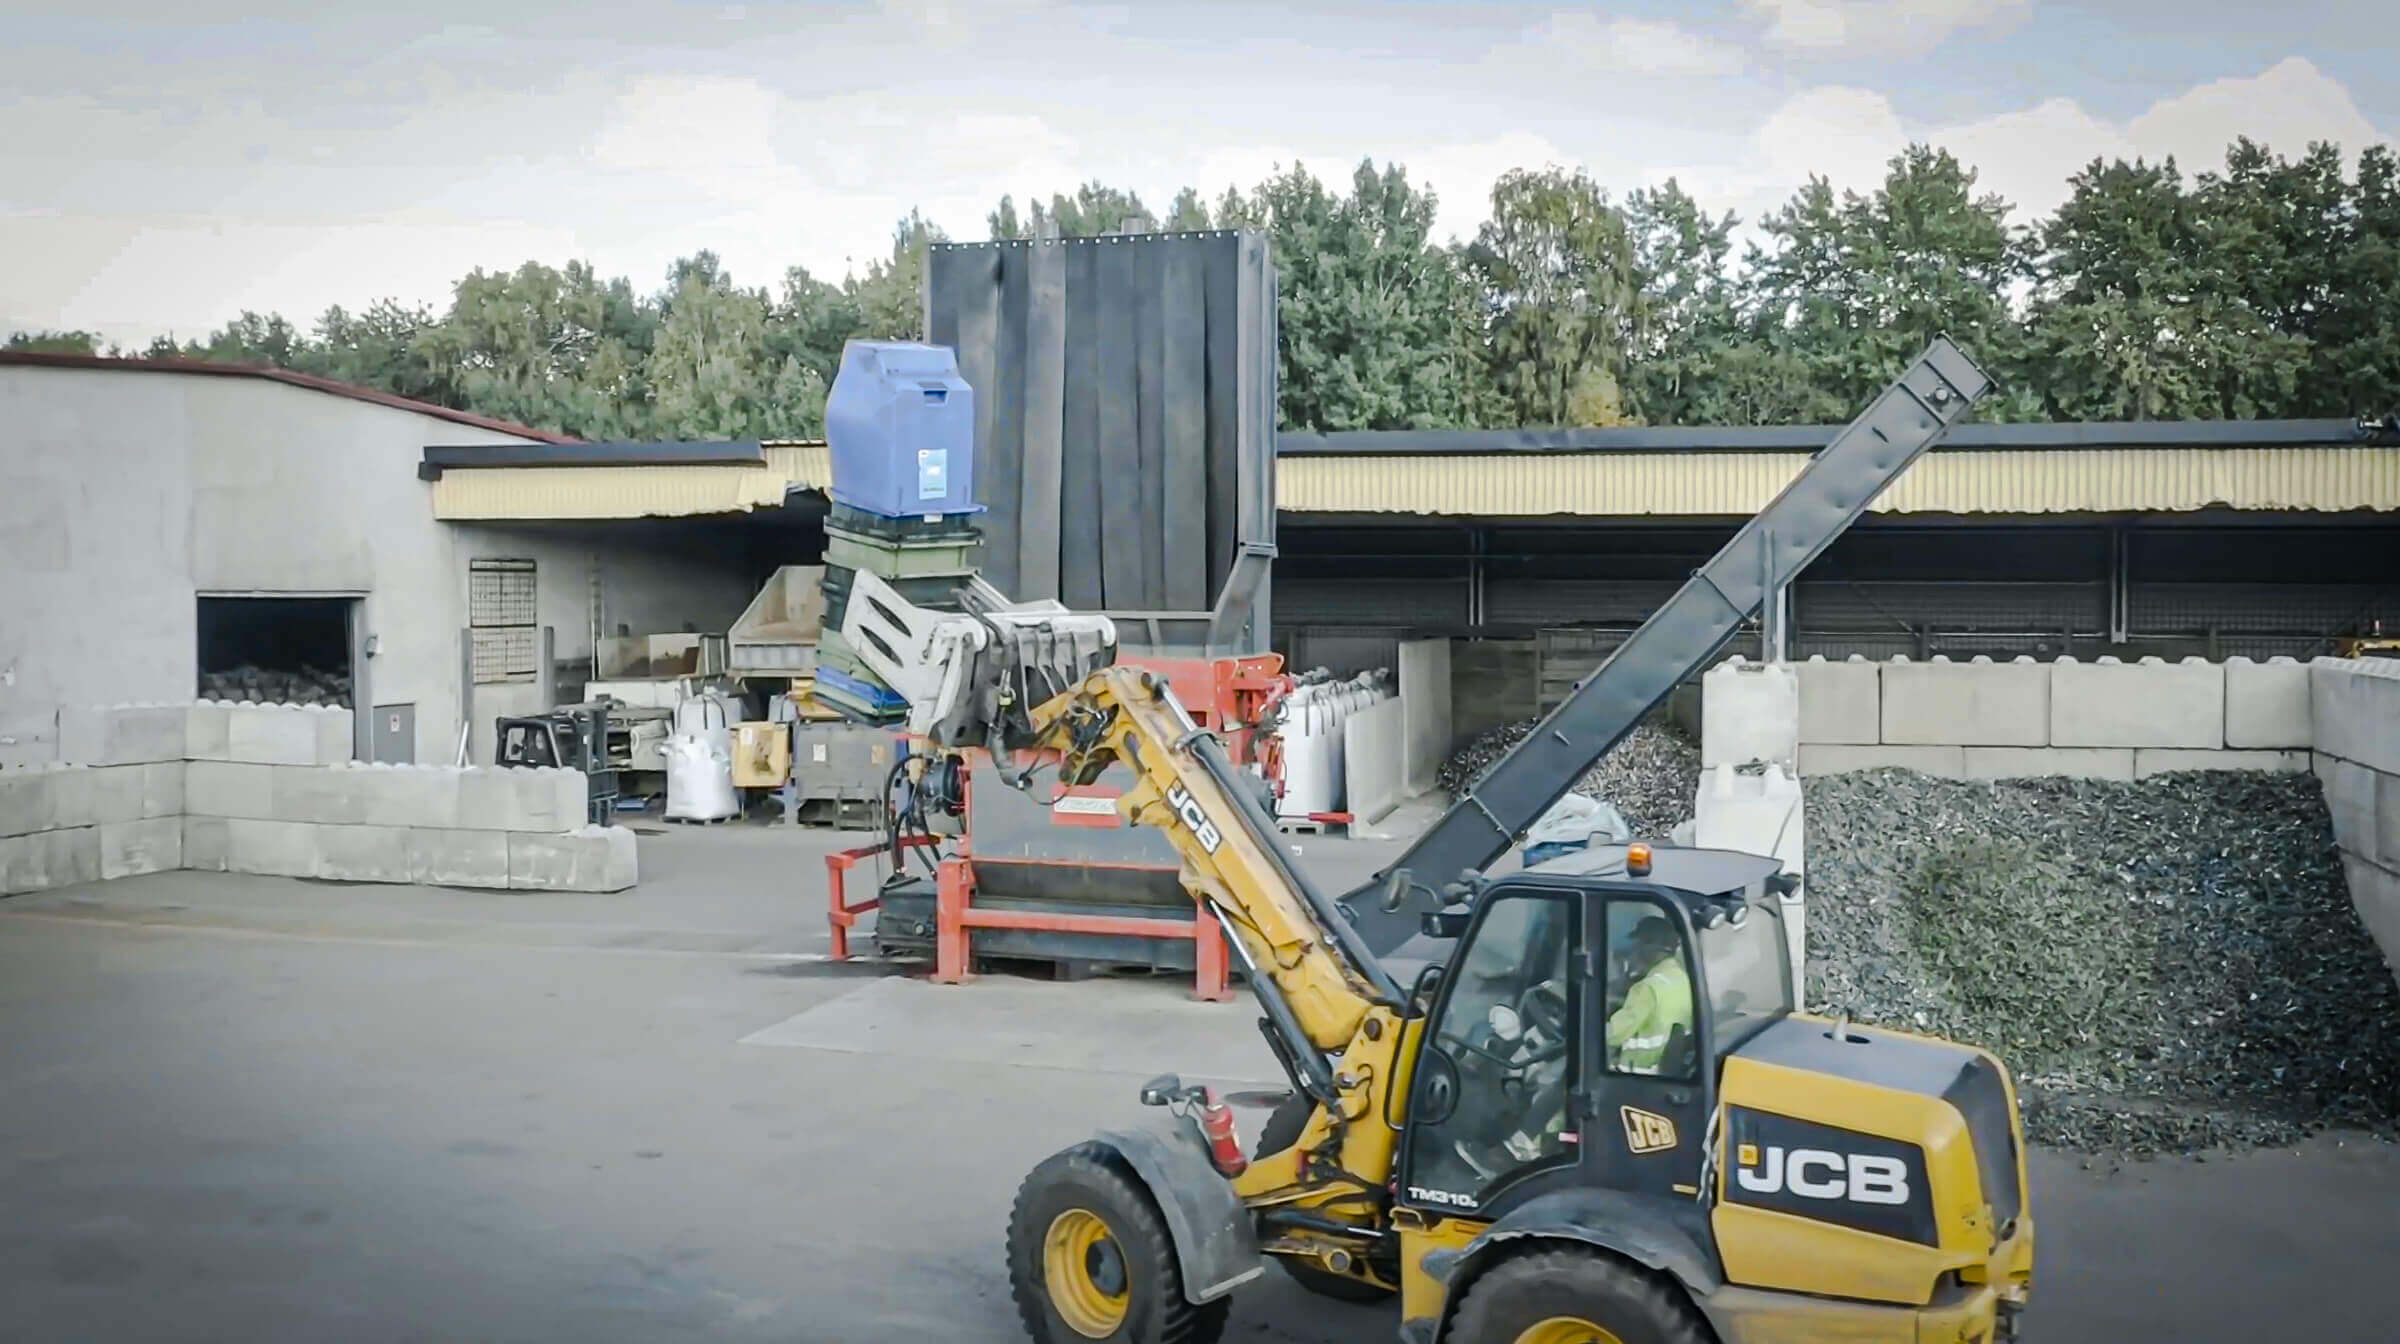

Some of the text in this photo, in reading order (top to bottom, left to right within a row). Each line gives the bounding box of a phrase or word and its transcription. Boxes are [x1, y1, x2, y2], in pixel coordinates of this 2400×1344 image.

[1167, 786, 1221, 854] JCB
[1629, 1112, 1675, 1149] JCB
[1737, 1146, 1909, 1205] JCB
